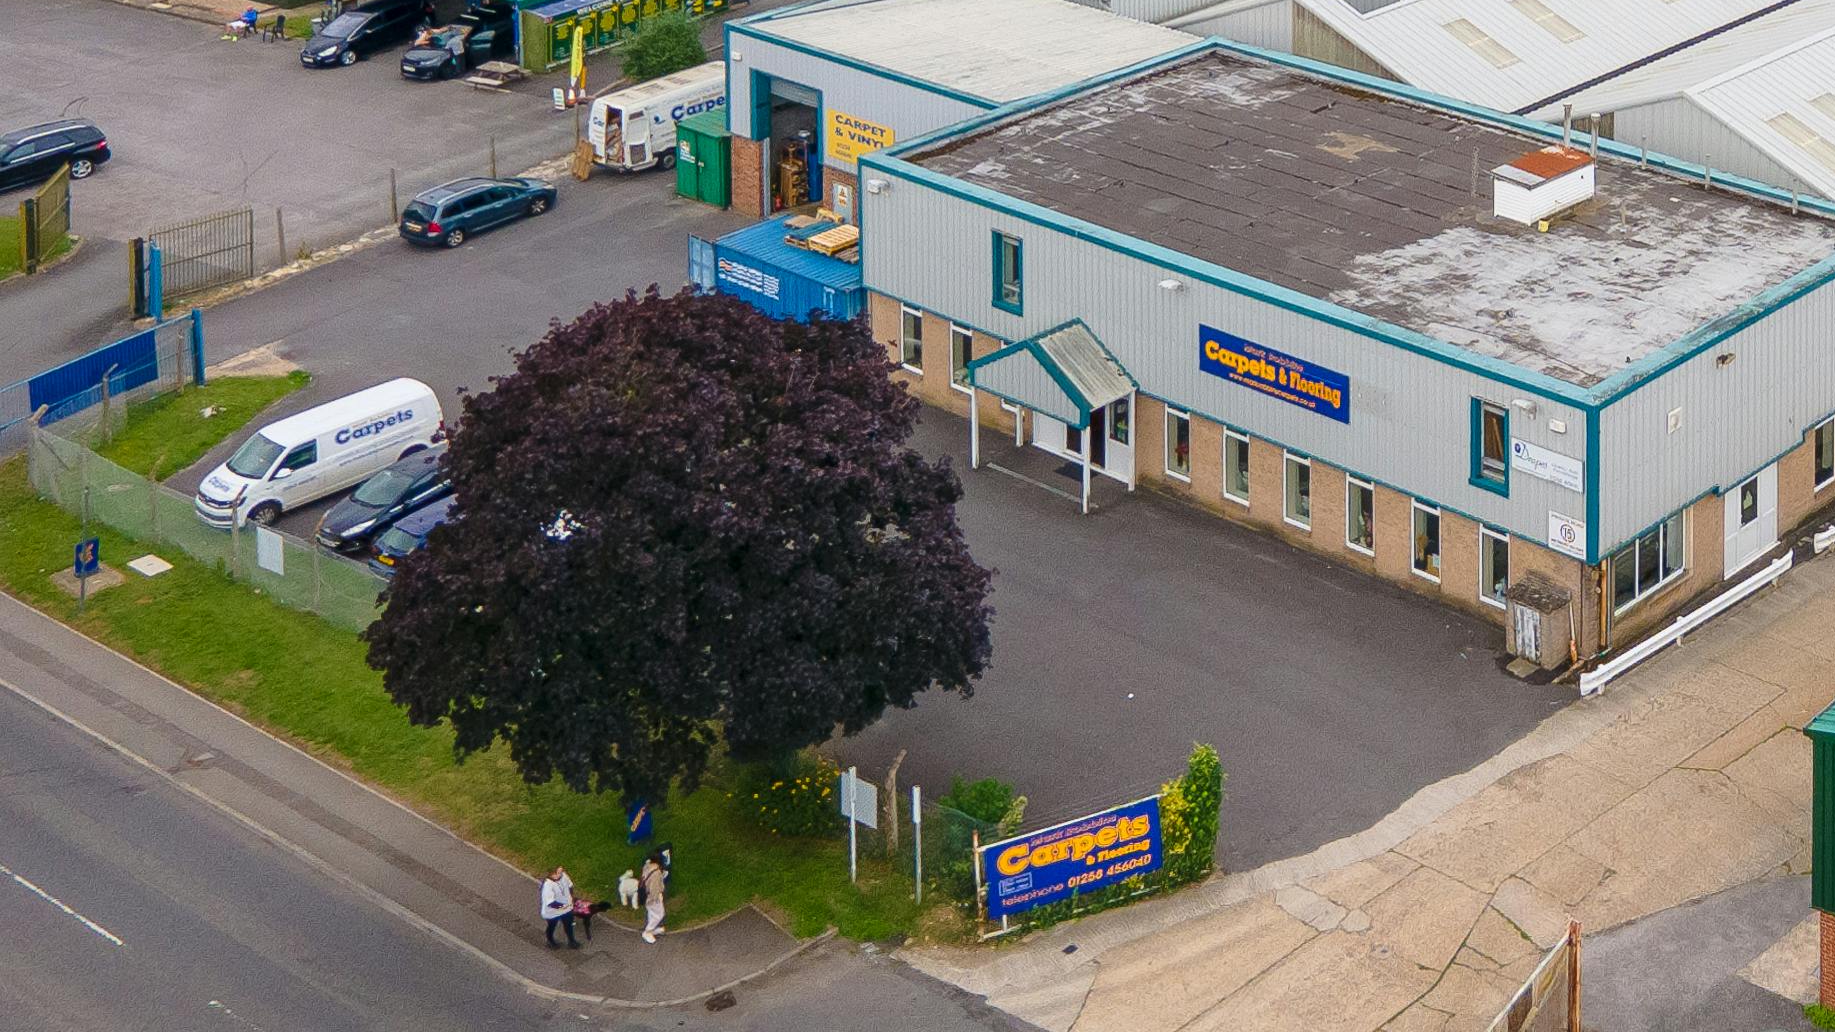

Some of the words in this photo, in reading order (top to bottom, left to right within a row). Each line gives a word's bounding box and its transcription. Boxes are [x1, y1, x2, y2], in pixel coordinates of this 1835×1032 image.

[671, 96, 725, 121] Carpe
[835, 114, 886, 138] CARPET
[835, 127, 843, 137] &
[1205, 340, 1276, 382] Carpets
[1278, 366, 1287, 386] &
[1289, 370, 1342, 409] Flooring
[335, 409, 414, 445] Carpets
[997, 815, 1150, 876] Carpets
[1097, 839, 1151, 863] Flooring
[1002, 883, 1064, 906] telephone
[1067, 869, 1103, 888] 01258
[1106, 854, 1152, 876] 456040
